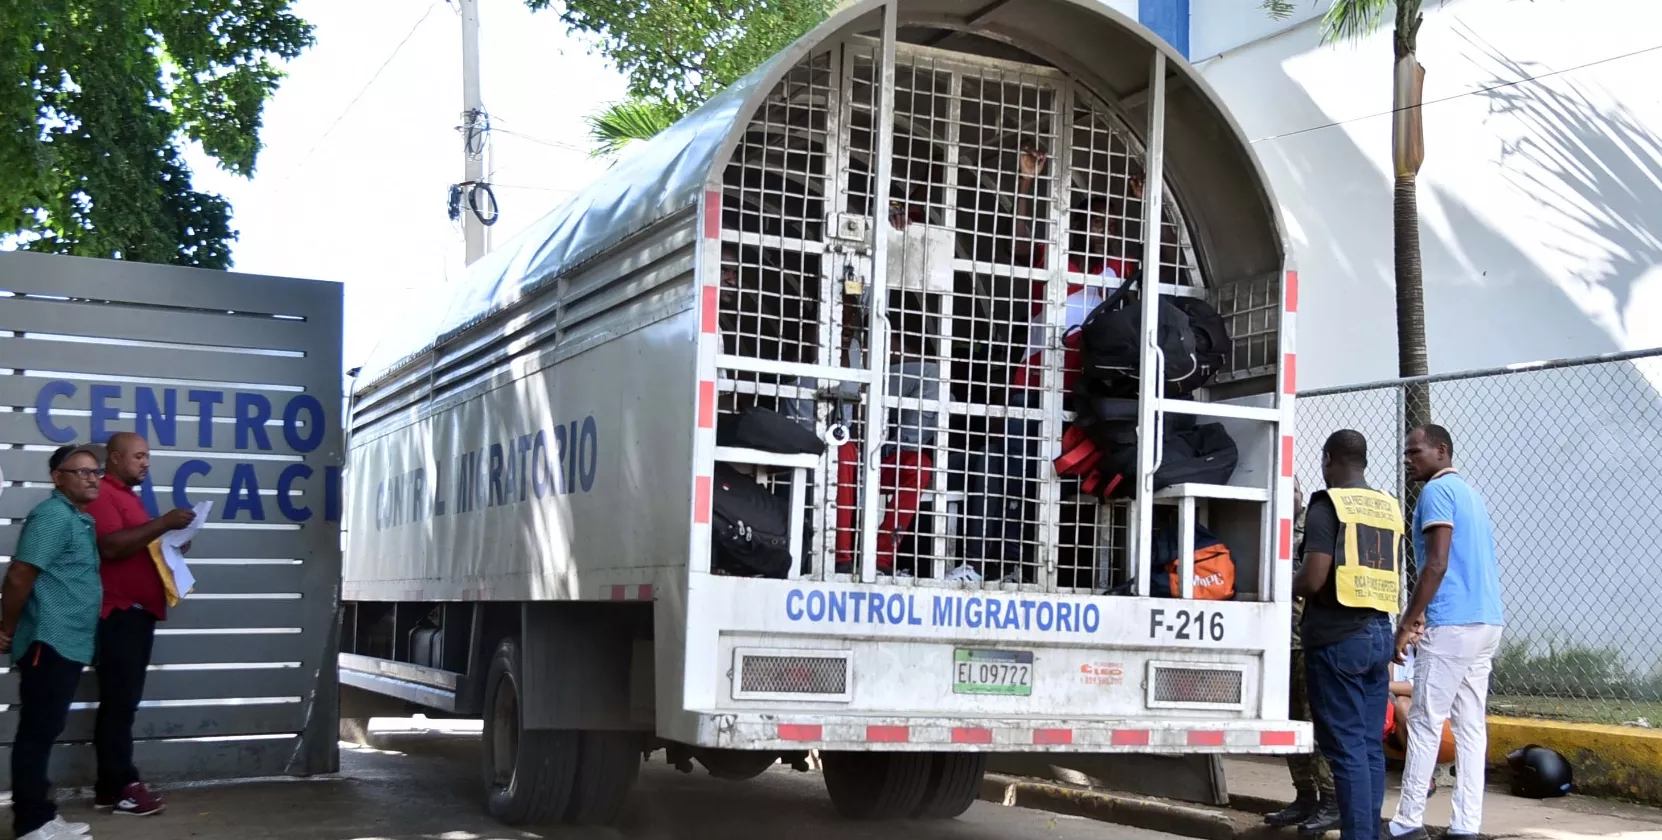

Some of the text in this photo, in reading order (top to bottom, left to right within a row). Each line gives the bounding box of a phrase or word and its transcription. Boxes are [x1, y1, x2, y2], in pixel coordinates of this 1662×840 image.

[35, 380, 326, 453] CENTRO
[375, 460, 446, 532] CONTRL
[786, 588, 1100, 634] CONTROL MIGRATORIO
[1149, 608, 1225, 642] F-216
